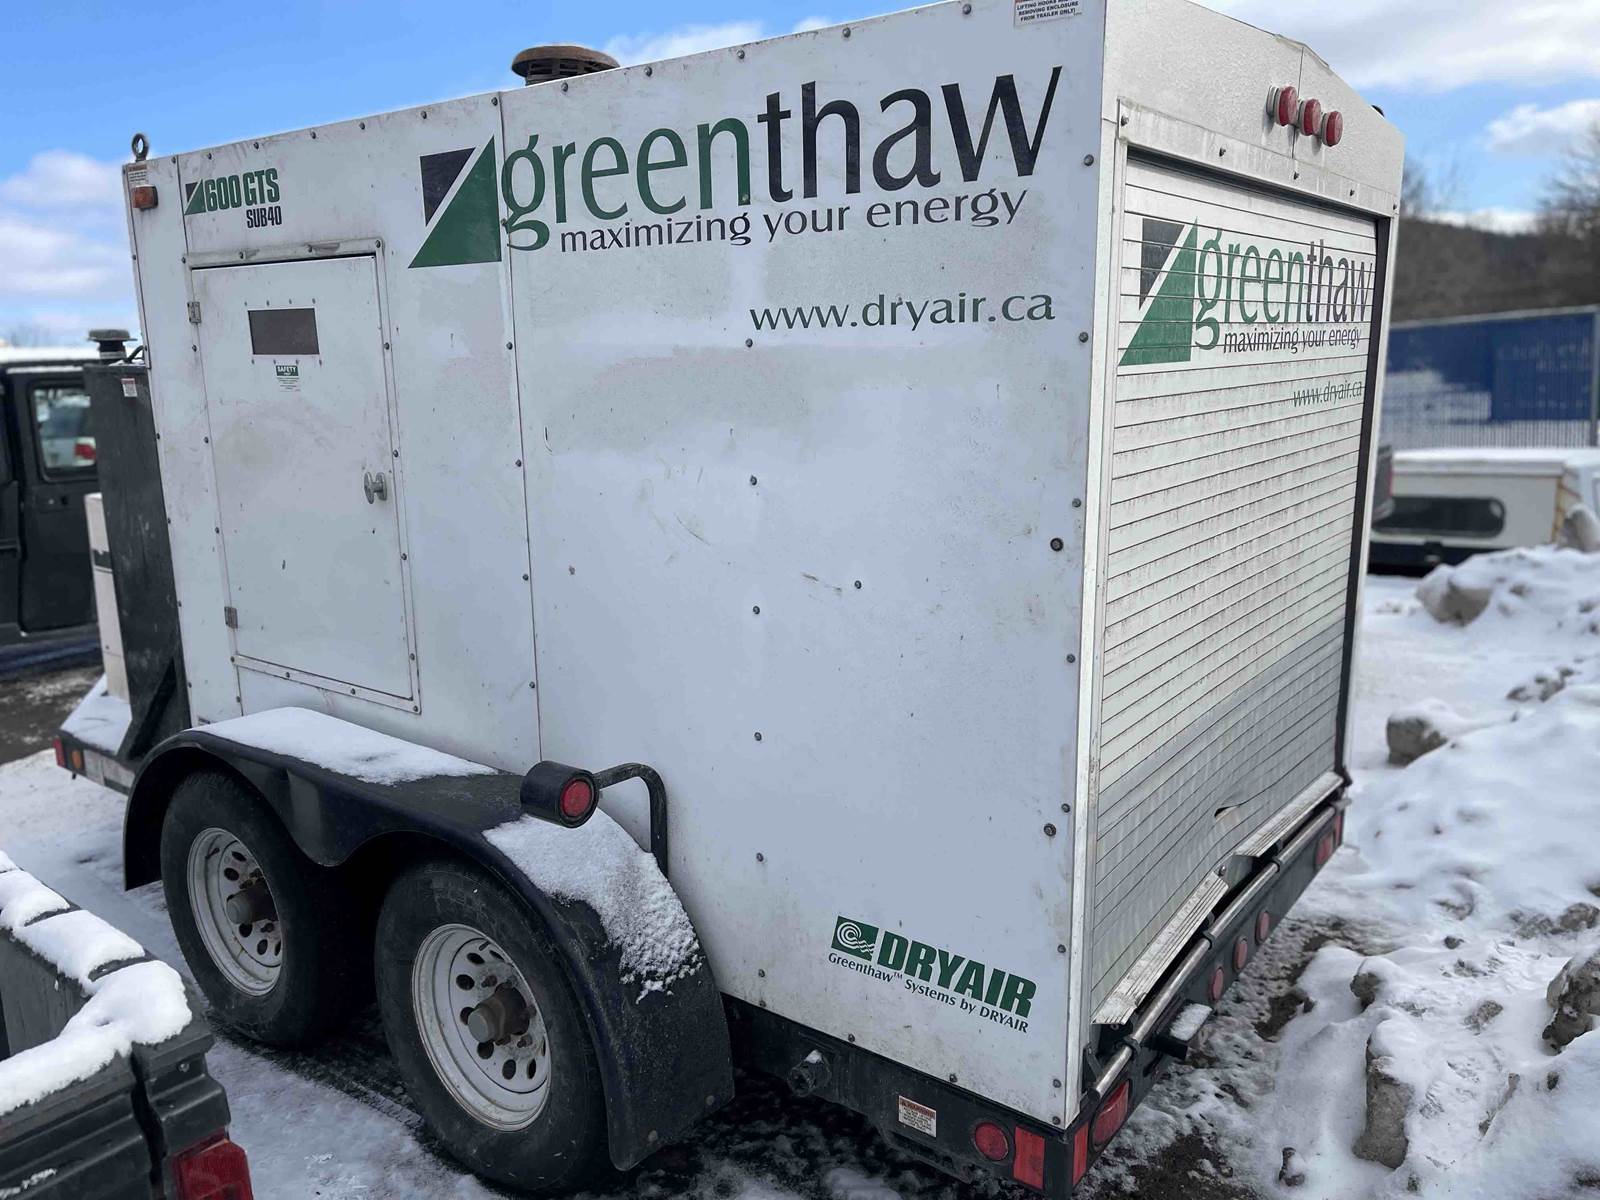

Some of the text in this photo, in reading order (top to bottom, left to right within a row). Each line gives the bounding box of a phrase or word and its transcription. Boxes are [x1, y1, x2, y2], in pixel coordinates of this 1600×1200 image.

[1018, 1, 1079, 16] REMOVING ENCLOSURE
[1020, 14, 1036, 22] FROM
[501, 66, 1062, 252] greenthaw
[204, 167, 280, 212] 600 GTS
[246, 206, 282, 228] SUB40
[560, 188, 1028, 252] maximizing your energy
[1195, 228, 1373, 350] greenthaw
[749, 292, 1056, 332] www.dryair.ca
[1223, 326, 1362, 355] maximizing your energy
[876, 930, 1037, 1018] DRYAIR
[904, 978, 957, 1006] Systems
[959, 998, 977, 1015] by
[979, 1006, 1029, 1033] DRYAIR
